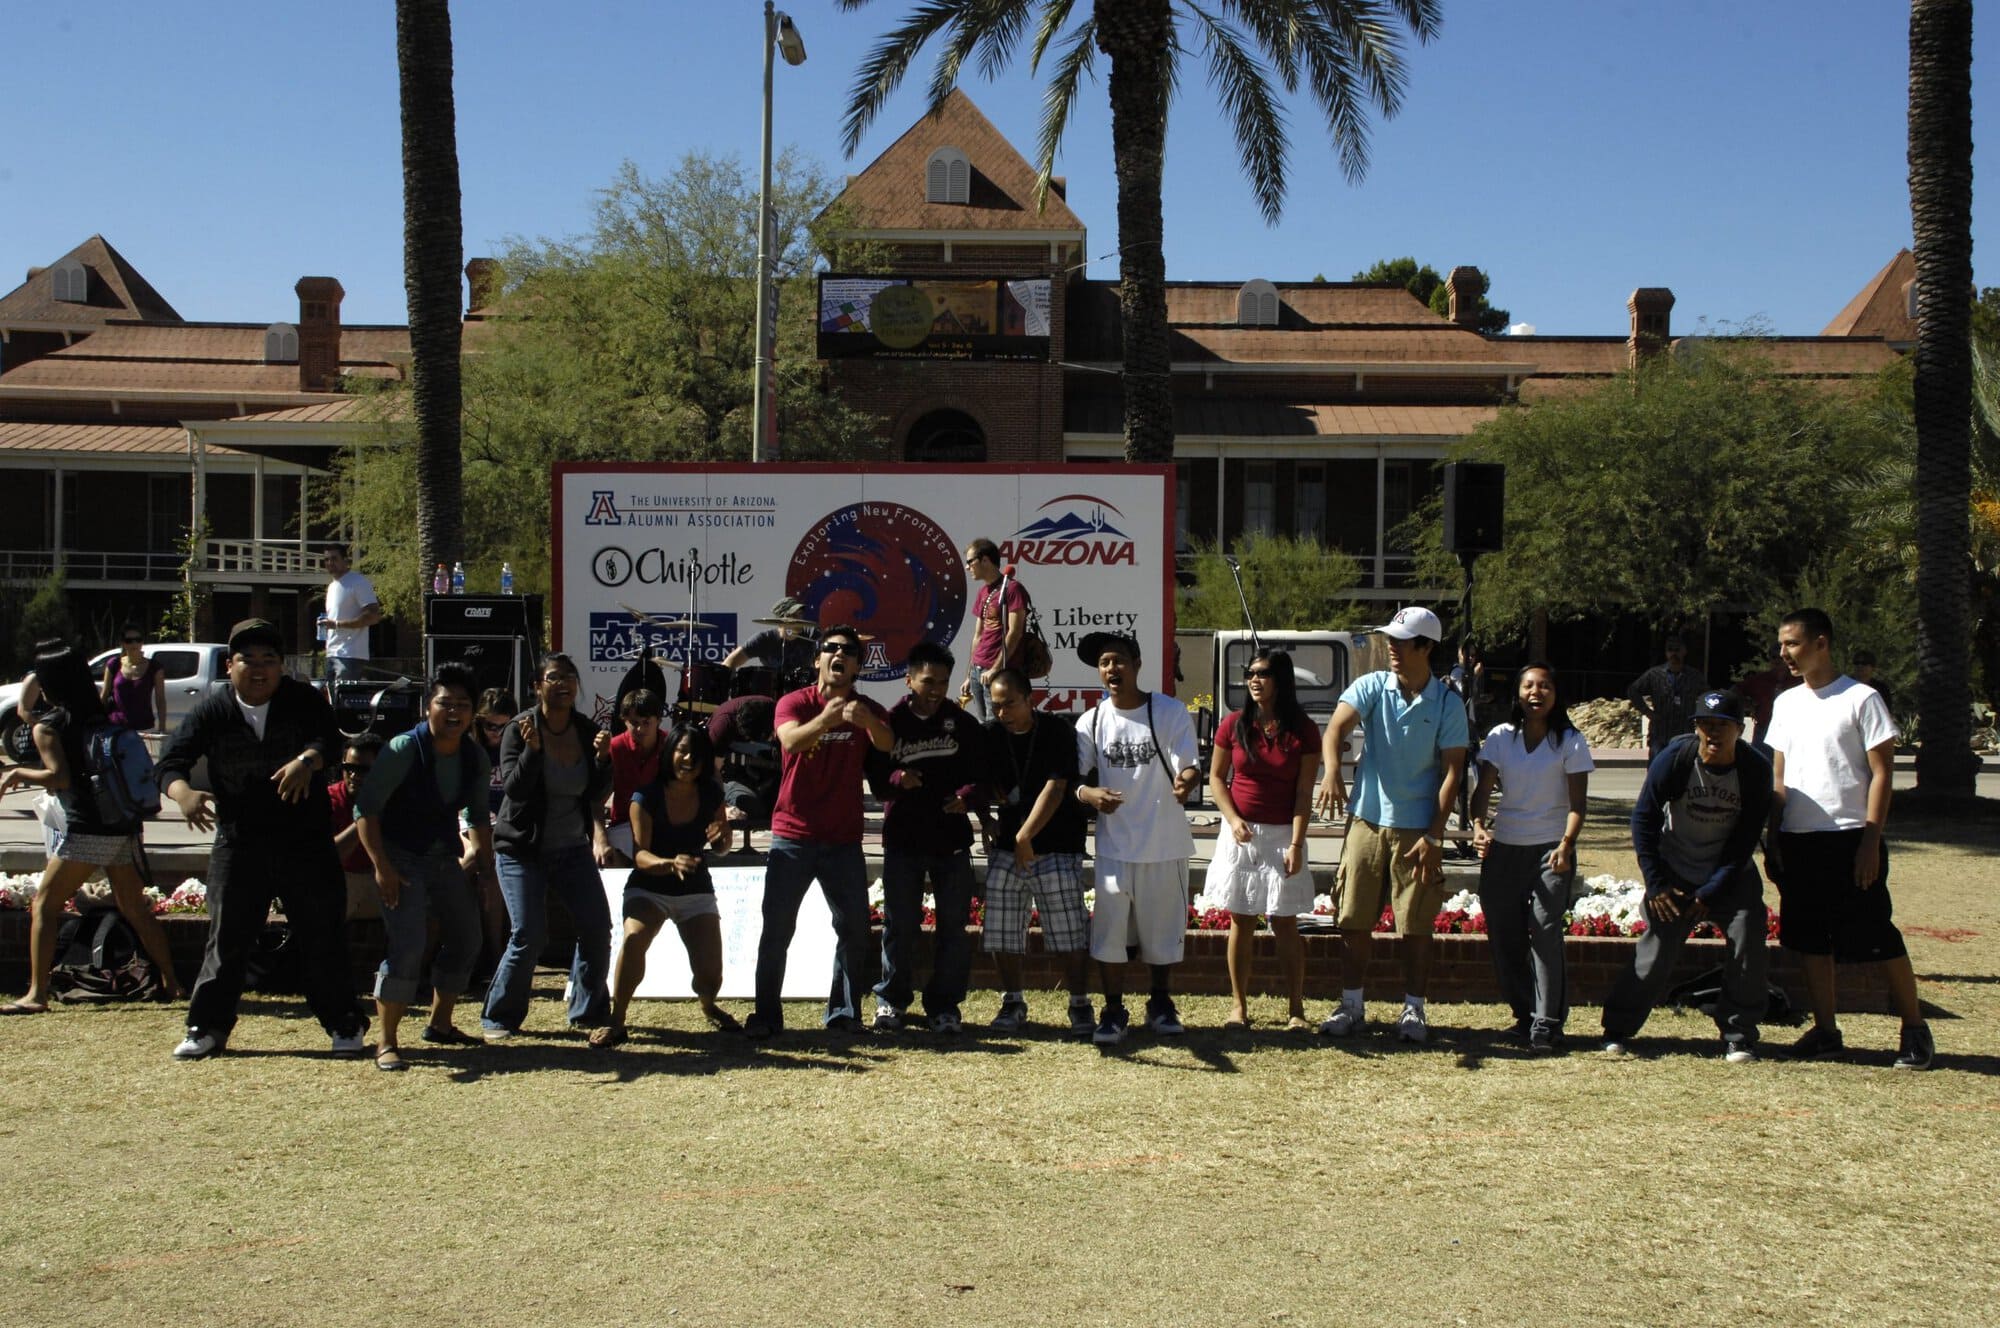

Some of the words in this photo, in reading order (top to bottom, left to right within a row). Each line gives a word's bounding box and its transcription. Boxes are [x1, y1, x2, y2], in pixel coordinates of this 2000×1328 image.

[585, 491, 621, 525] A
[632, 495, 649, 506] THE
[654, 495, 713, 507] UNIVERSITY
[716, 495, 728, 506] OF
[732, 495, 776, 506] ARIZONA
[628, 512, 679, 526] ALUMNI
[687, 513, 775, 527] ASSOCIATION
[794, 509, 858, 566] Exploring
[863, 505, 889, 517] New
[894, 507, 955, 566] Frontiers
[1000, 540, 1135, 566] ARIZONA
[635, 547, 754, 594] Chipotle
[464, 607, 493, 618] CRATE
[1054, 606, 1138, 630] Liberty
[592, 647, 735, 660] FOUDATION
[862, 642, 890, 670] A
